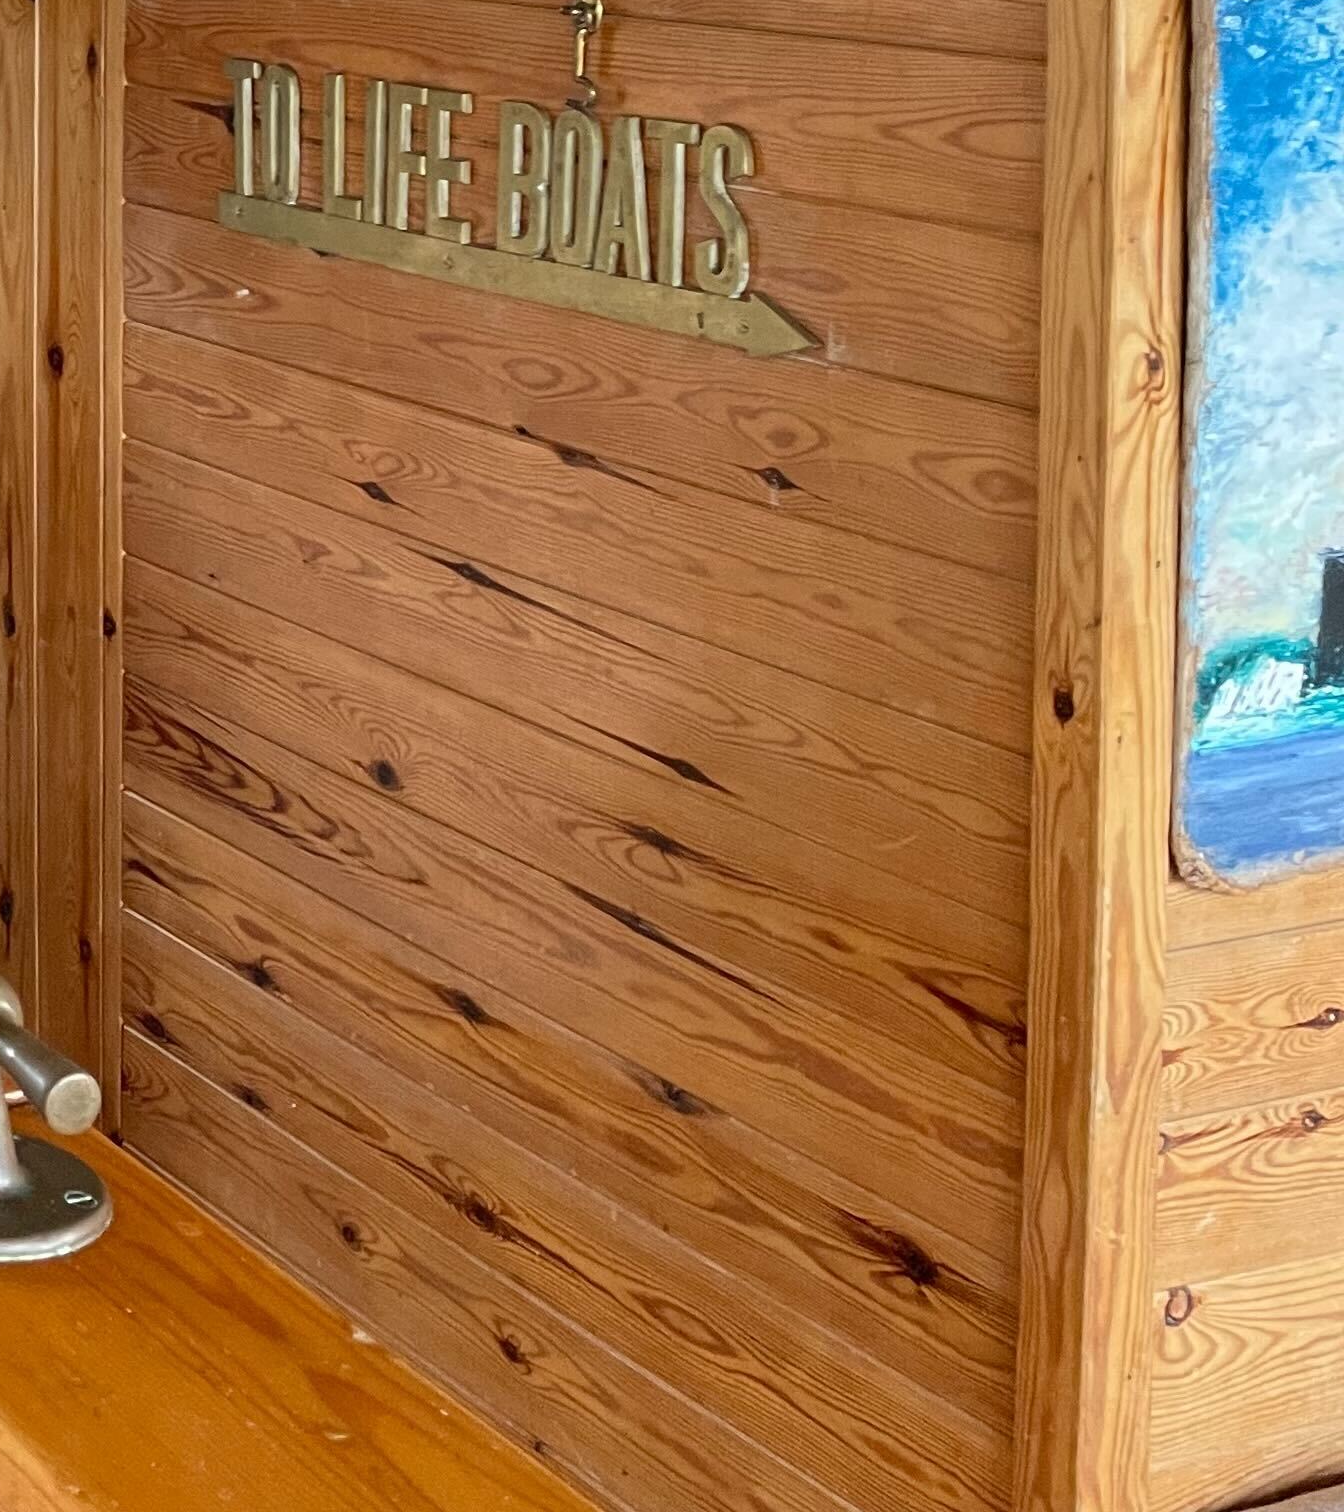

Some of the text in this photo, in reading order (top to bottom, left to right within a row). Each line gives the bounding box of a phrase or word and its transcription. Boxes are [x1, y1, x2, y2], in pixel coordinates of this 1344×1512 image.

[224, 57, 754, 299] TO LIFE BOATS
